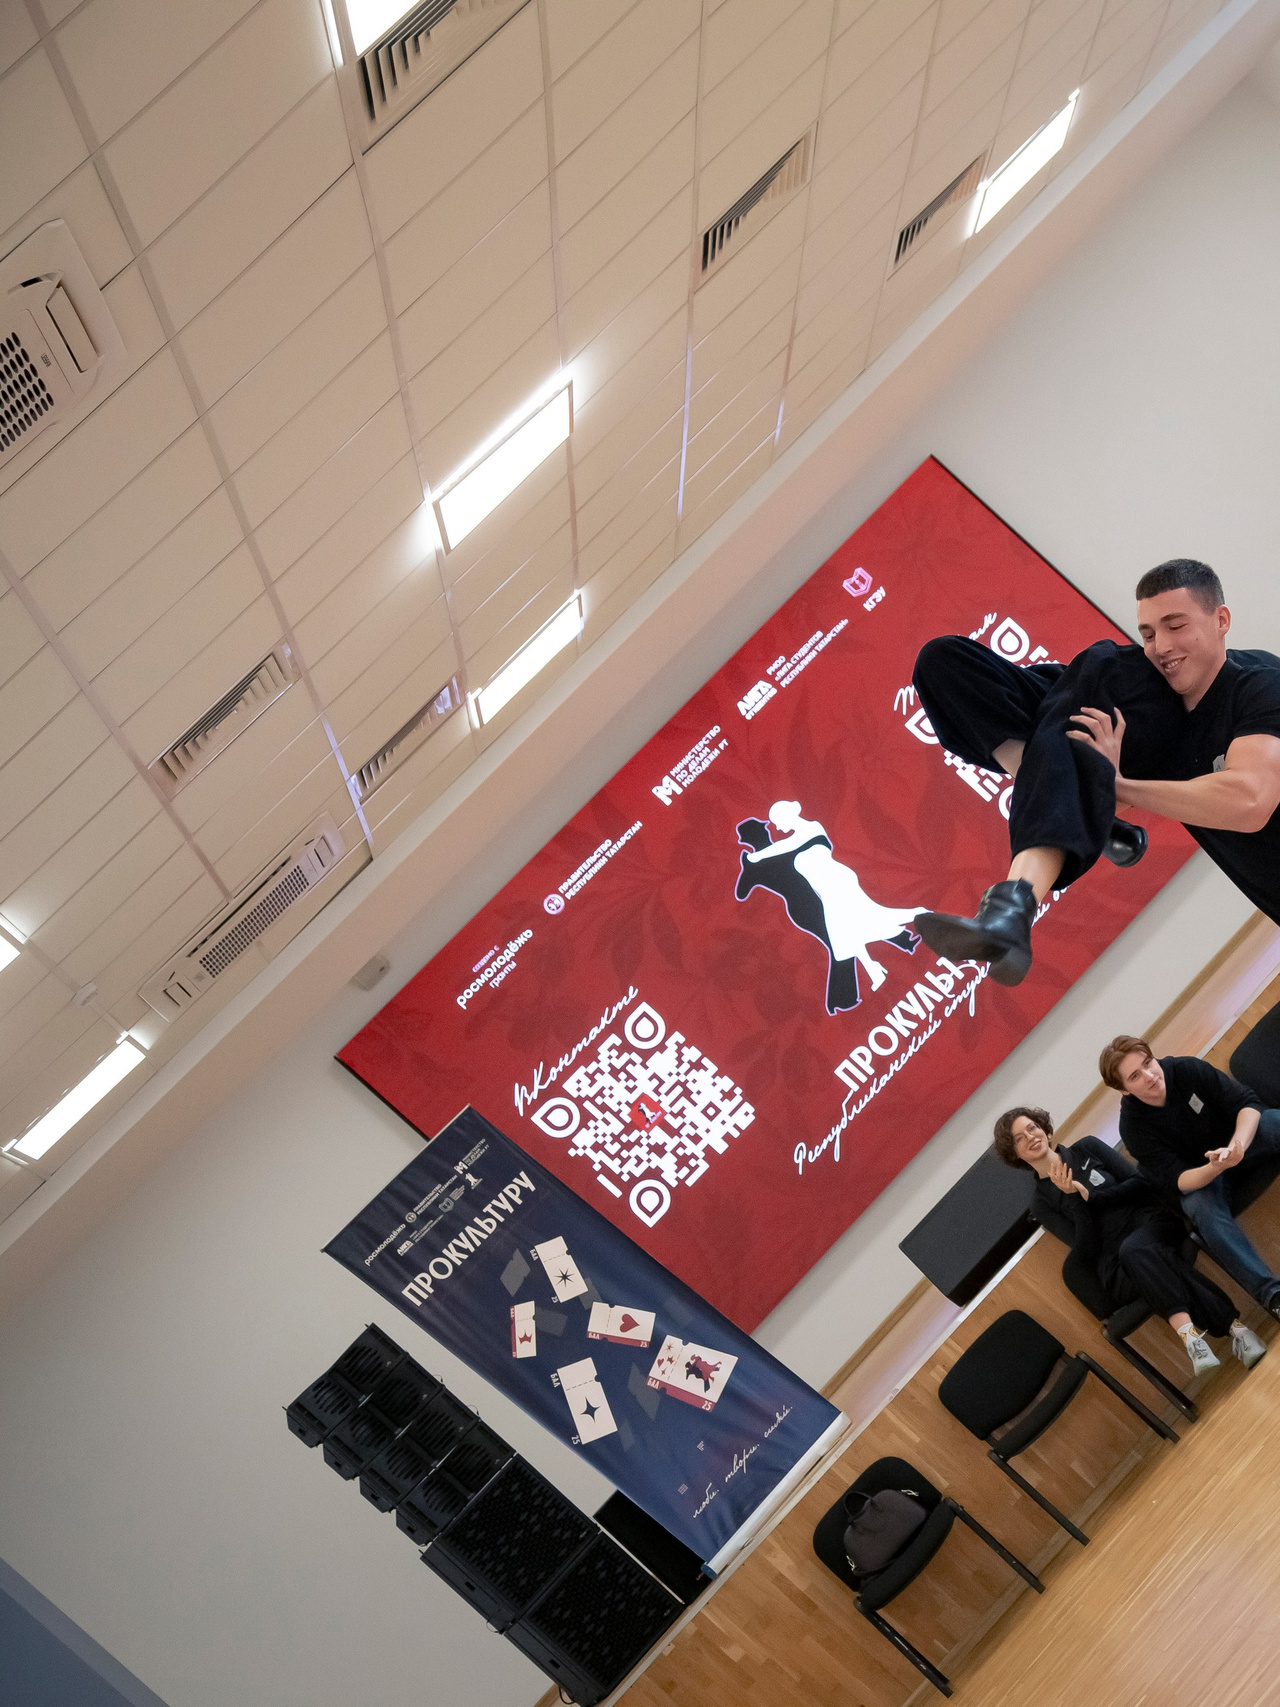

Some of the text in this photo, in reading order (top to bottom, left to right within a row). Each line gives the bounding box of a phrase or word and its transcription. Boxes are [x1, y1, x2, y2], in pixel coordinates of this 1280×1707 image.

[863, 586, 886, 612] КГЭУ
[736, 679, 773, 716] ЛИГА
[669, 725, 721, 777] МИНИСТЕРСТВО
[718, 738, 729, 751] РТ
[675, 746, 711, 783] ПО ДЕЛАМ
[558, 839, 613, 894] ПРАВИТЕЛЬСТВО
[564, 820, 643, 900] РЕСПУБЛИКИ ТАТАРСТАН
[456, 929, 534, 1010] росмолодёжь
[489, 960, 518, 989] гранты
[834, 956, 977, 1092] ПРОКУЛЬТ
[514, 985, 639, 1117] ВКонтакте
[401, 1170, 536, 1307] ПРОКУЛЬТУРУ
[588, 1332, 601, 1340] БАЛ
[550, 1373, 561, 1388] БАЛ
[646, 1377, 660, 1390] БАЛ
[701, 1400, 713, 1411] 25
[571, 1434, 581, 1445] 25
